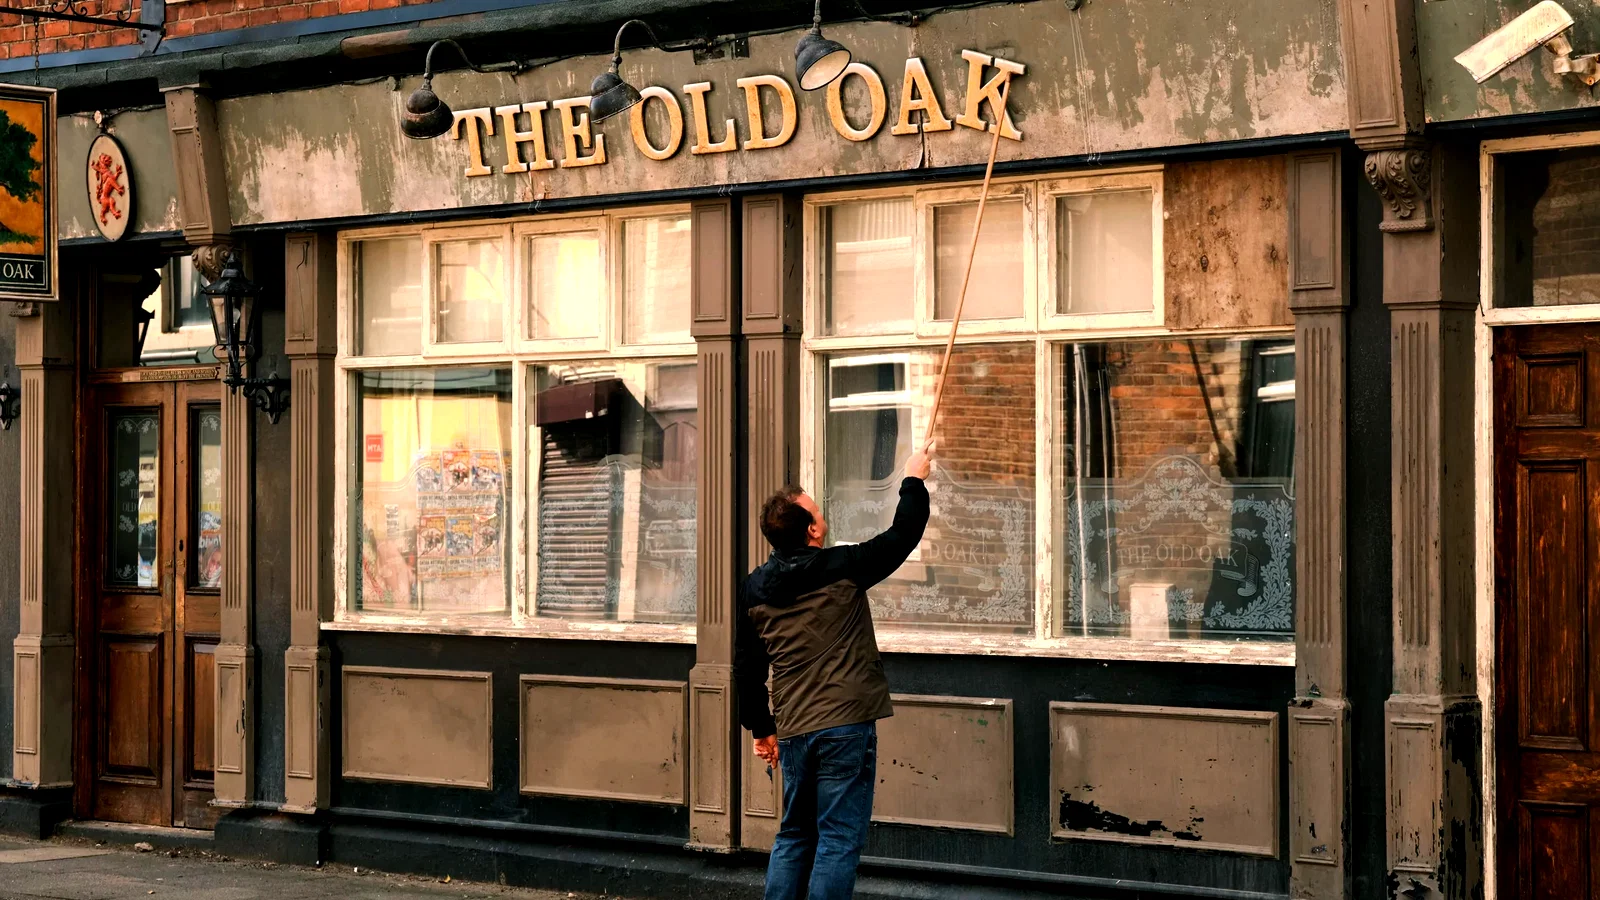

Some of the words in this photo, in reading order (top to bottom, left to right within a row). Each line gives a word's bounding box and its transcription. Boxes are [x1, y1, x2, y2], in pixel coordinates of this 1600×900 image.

[452, 95, 607, 177] THE
[630, 74, 797, 161] OLD
[826, 49, 1026, 142] OAK
[3, 262, 34, 279] OAK
[944, 542, 979, 564] OAK
[1116, 545, 1151, 566] THE
[1156, 543, 1194, 562] OLD
[1199, 544, 1239, 567] OAK
